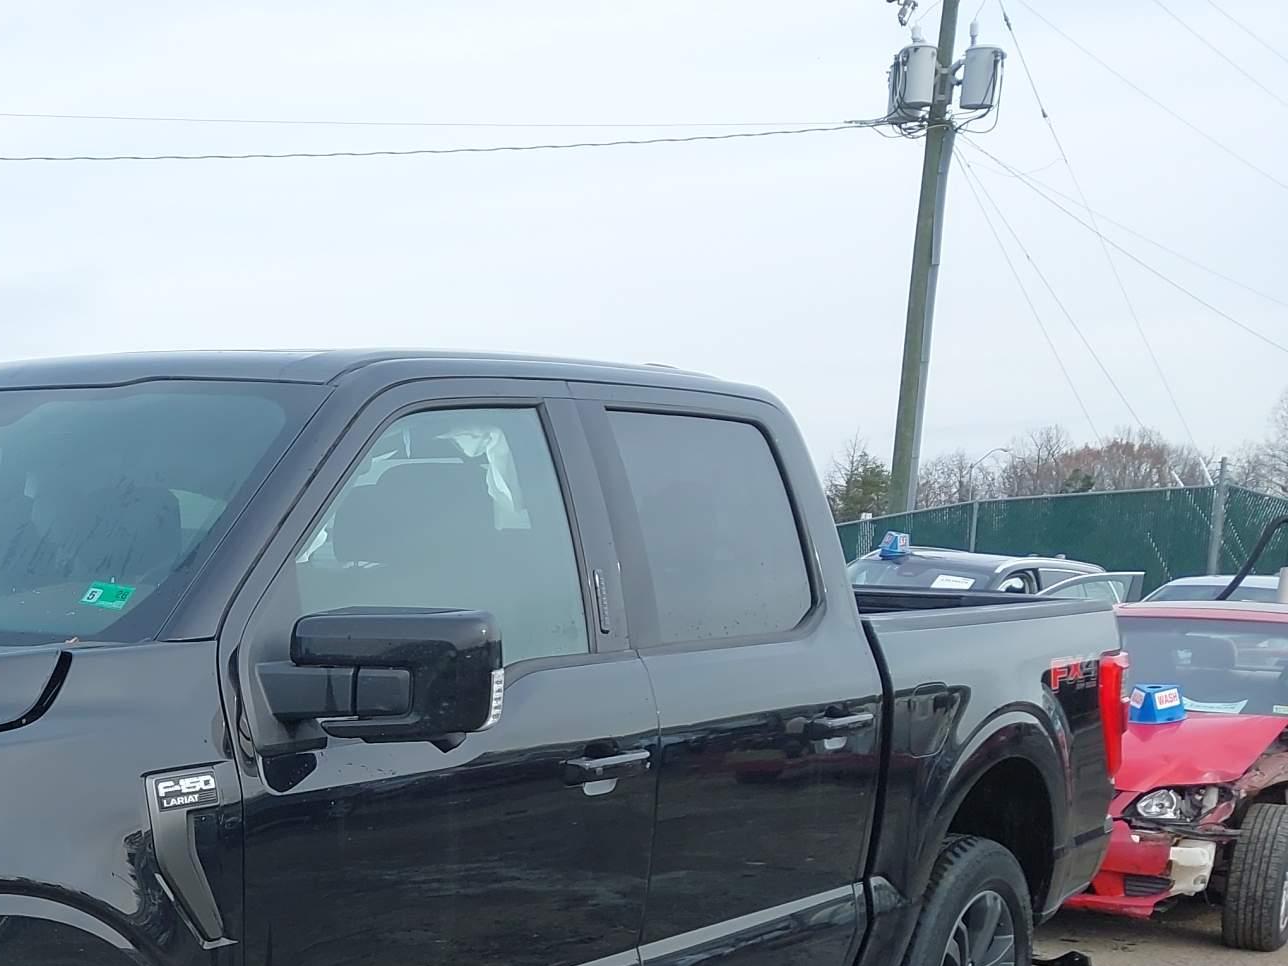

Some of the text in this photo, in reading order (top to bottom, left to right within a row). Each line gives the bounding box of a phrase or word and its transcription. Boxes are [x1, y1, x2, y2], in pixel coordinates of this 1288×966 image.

[1051, 657, 1097, 690] FX4
[1157, 692, 1177, 706] WASH
[158, 775, 215, 797] F-150
[163, 794, 199, 807] LARIAT
